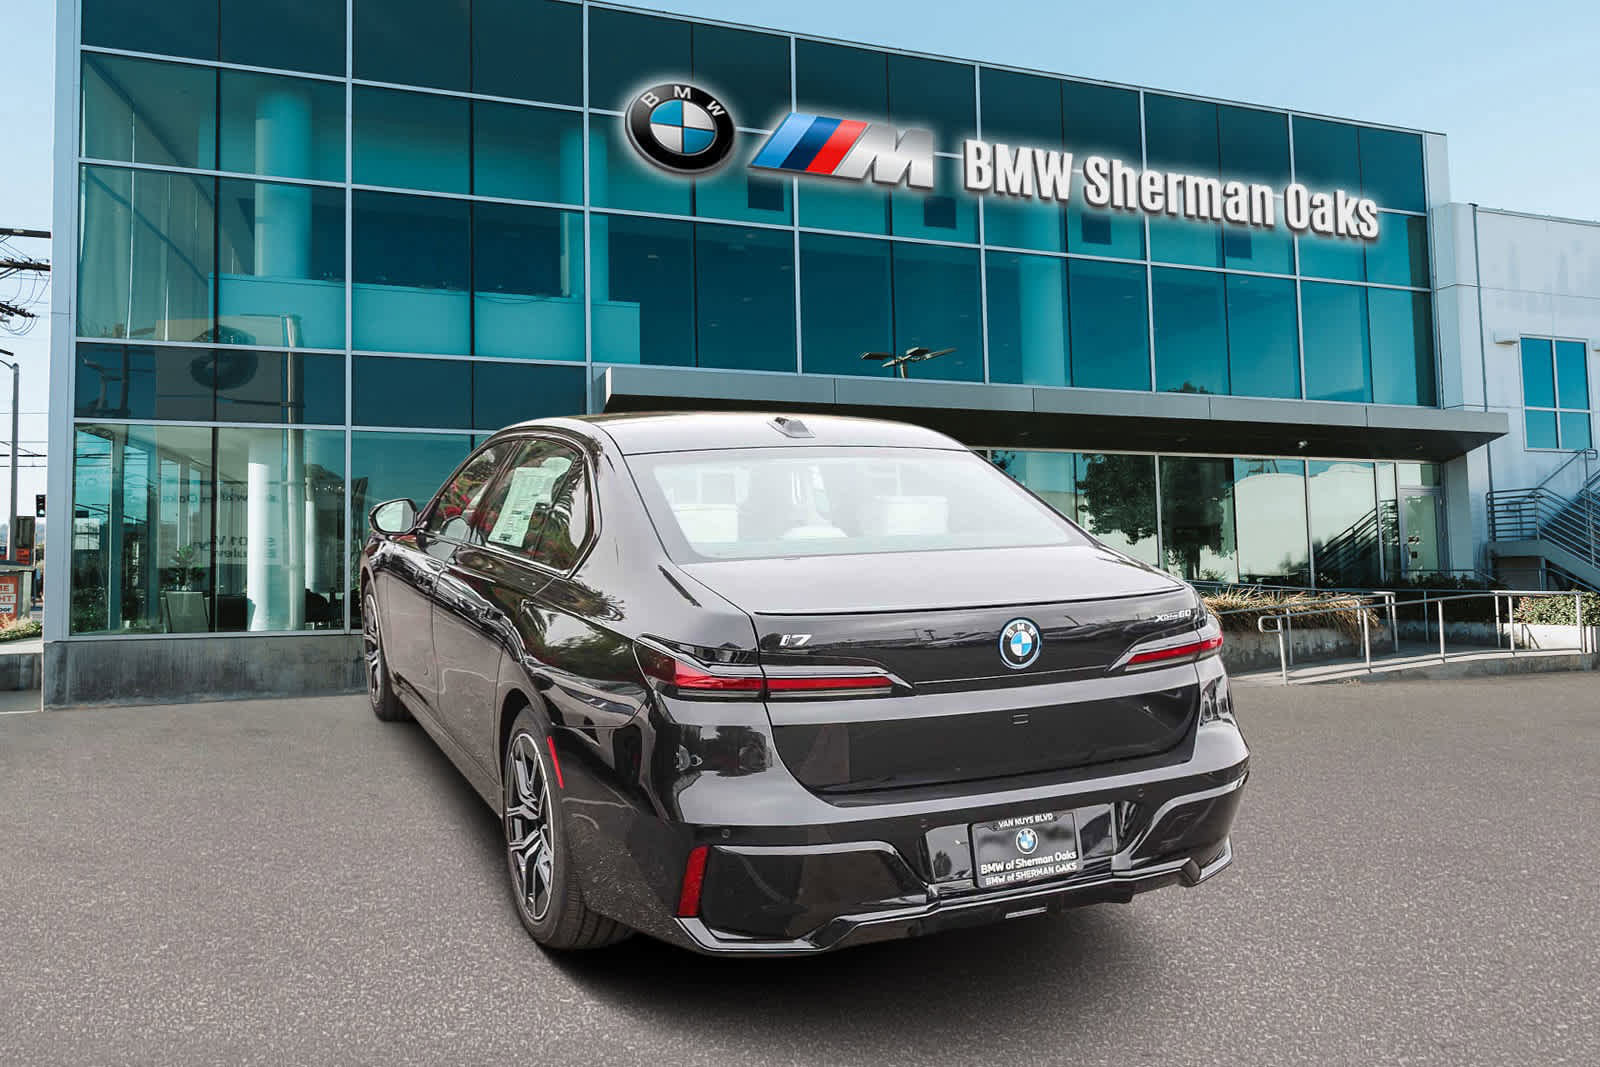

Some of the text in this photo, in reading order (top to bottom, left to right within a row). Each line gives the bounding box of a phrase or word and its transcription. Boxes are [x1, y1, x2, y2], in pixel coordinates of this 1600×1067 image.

[641, 85, 725, 117] BMW
[963, 139, 1379, 241] BMW Sherman Oaks
[1006, 623, 1036, 637] BMW
[998, 812, 1053, 828] VAN NUYS BLVD
[980, 850, 1077, 875] BMW of Sherman Oaks
[985, 862, 1077, 886] BMW of SHERMAN OAKS
